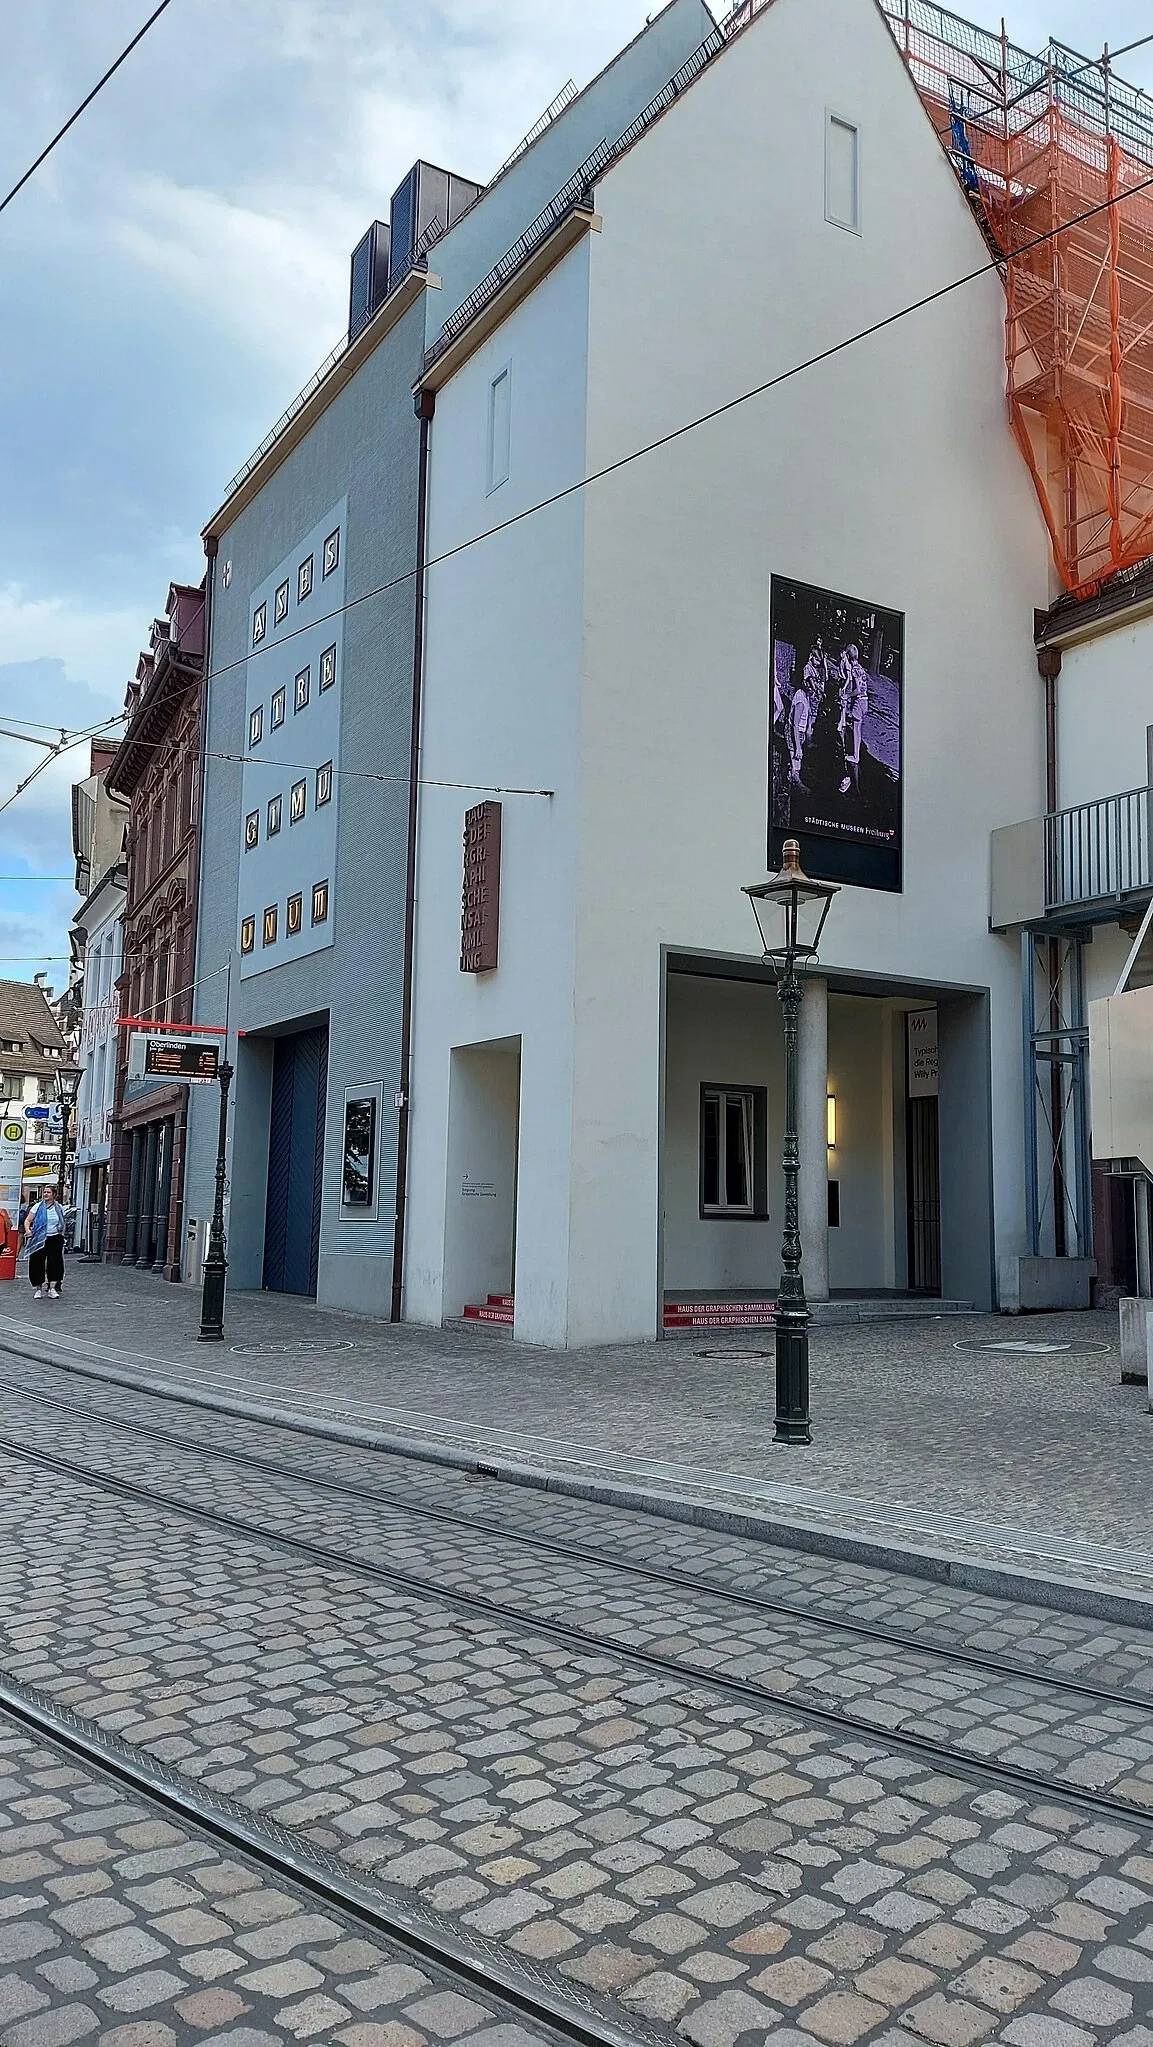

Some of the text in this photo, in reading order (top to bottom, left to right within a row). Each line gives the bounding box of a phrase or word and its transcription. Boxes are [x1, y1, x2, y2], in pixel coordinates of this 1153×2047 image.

[805, 816, 890, 841] STÄDTISCHE MUSEEN Freiburg
[149, 1040, 187, 1050] Oberlinden
[913, 1058, 925, 1067] die
[913, 1069, 930, 1080] Willy
[9, 1126, 18, 1138] H
[677, 1303, 776, 1313] HAUS DER GRAPHISCHEN SAMMLUNG
[692, 1317, 709, 1325] HAUS
[708, 1317, 721, 1325] DER
[720, 1316, 759, 1325] GRAPHISCHEN
